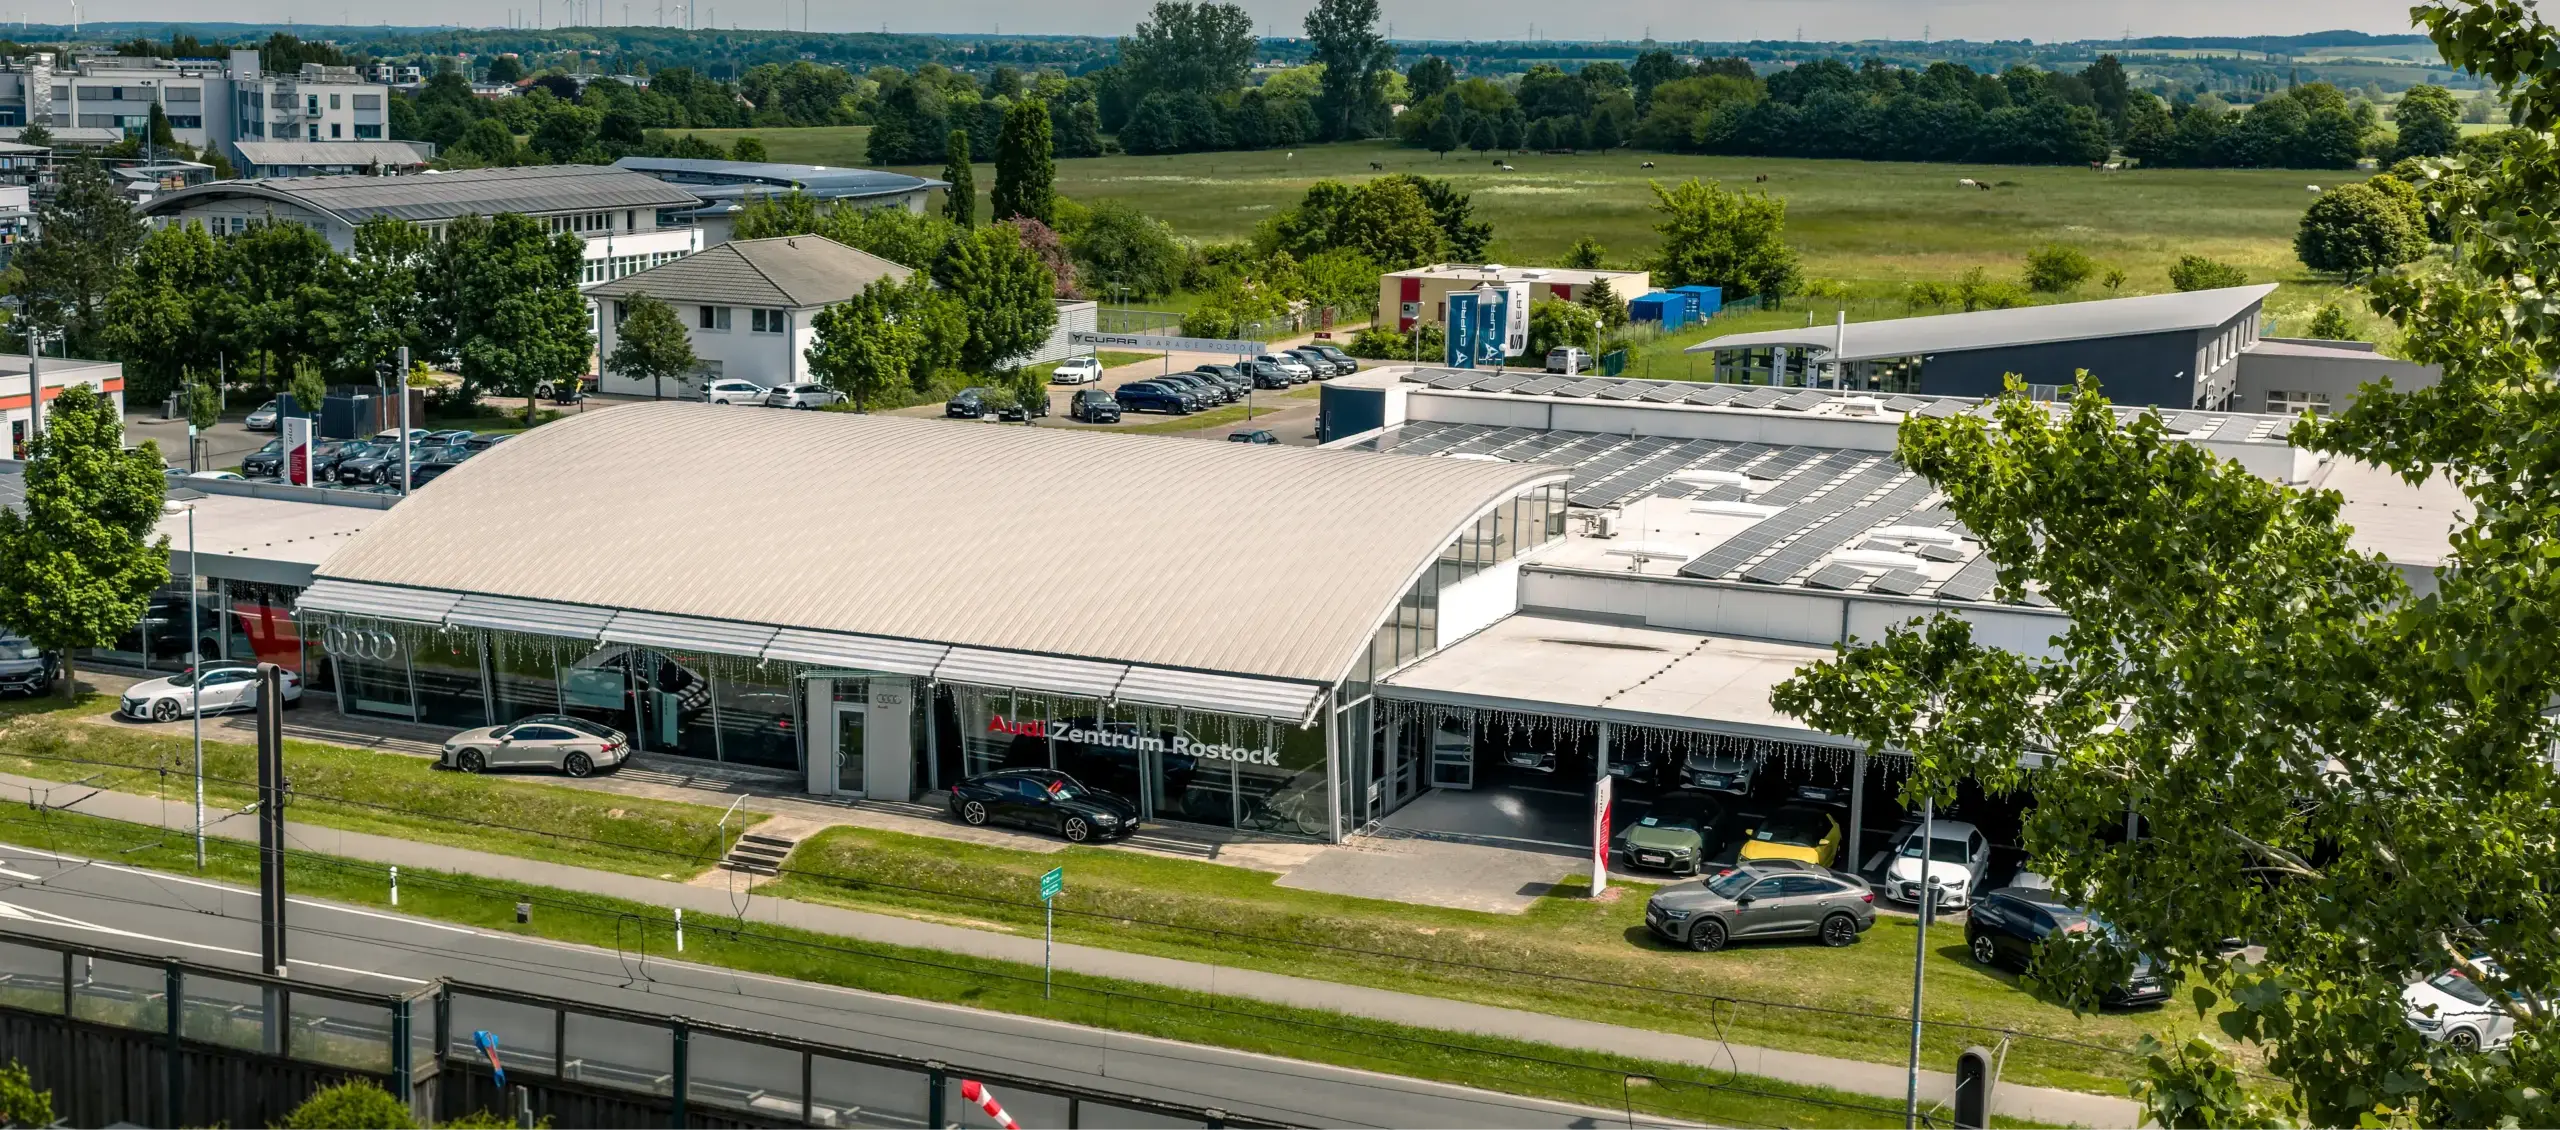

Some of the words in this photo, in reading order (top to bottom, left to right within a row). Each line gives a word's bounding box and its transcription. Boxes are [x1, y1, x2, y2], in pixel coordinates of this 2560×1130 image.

[1084, 335, 1138, 346] CUPRA
[1145, 339, 1199, 349] GARAGE
[1208, 342, 1261, 352] ROSTOCK
[1460, 299, 1468, 347] CUPRA
[988, 714, 1046, 738] Audi
[1052, 722, 1164, 753] Zentrum
[1172, 735, 1280, 767] Rostock
